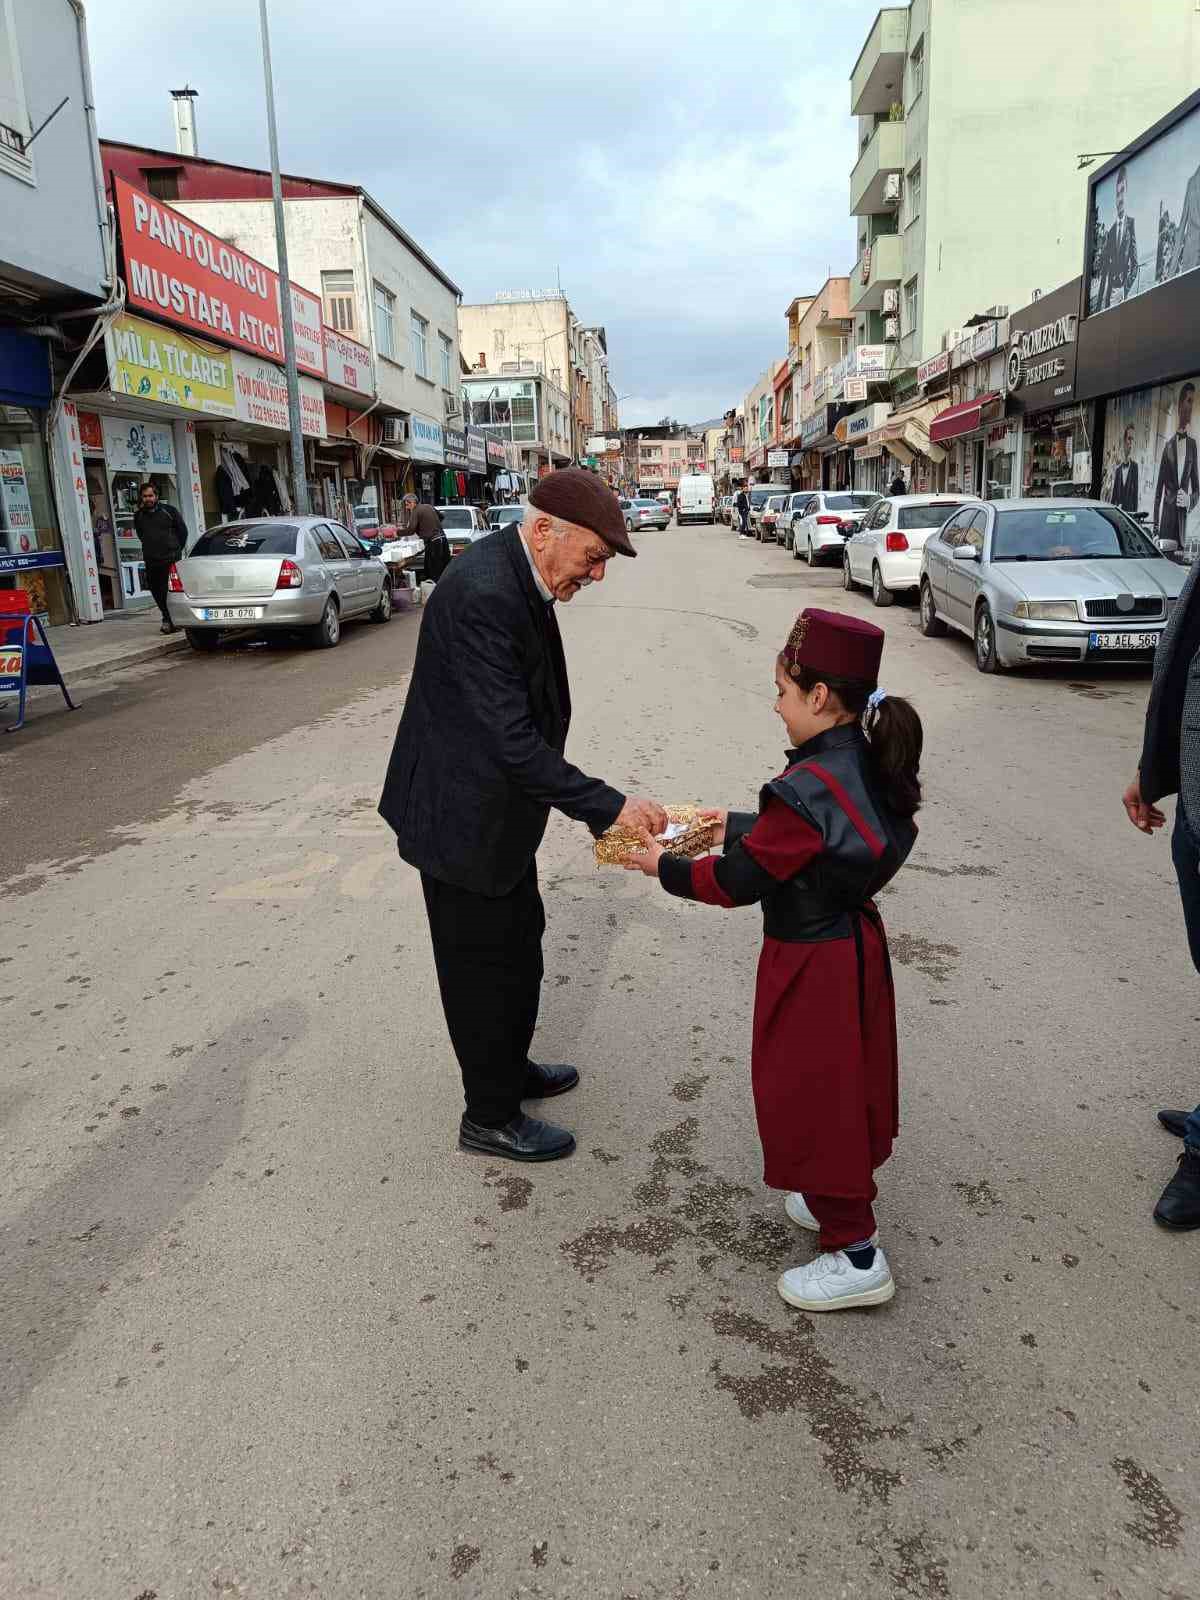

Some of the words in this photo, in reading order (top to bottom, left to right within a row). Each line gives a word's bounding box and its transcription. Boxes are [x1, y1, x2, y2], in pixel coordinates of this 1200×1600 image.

[132, 193, 268, 299] PANTOLONCU
[130, 258, 235, 336] MUSTAFA
[239, 310, 280, 354] ATICI
[112, 326, 162, 374] MİLA
[162, 341, 227, 390] TİCARET
[1026, 359, 1058, 386] PERFUME
[237, 368, 252, 397] TÜM
[239, 606, 253, 617] 070
[1098, 634, 1109, 647] 63
[1115, 634, 1131, 647] AEL
[1138, 634, 1157, 647] 569
